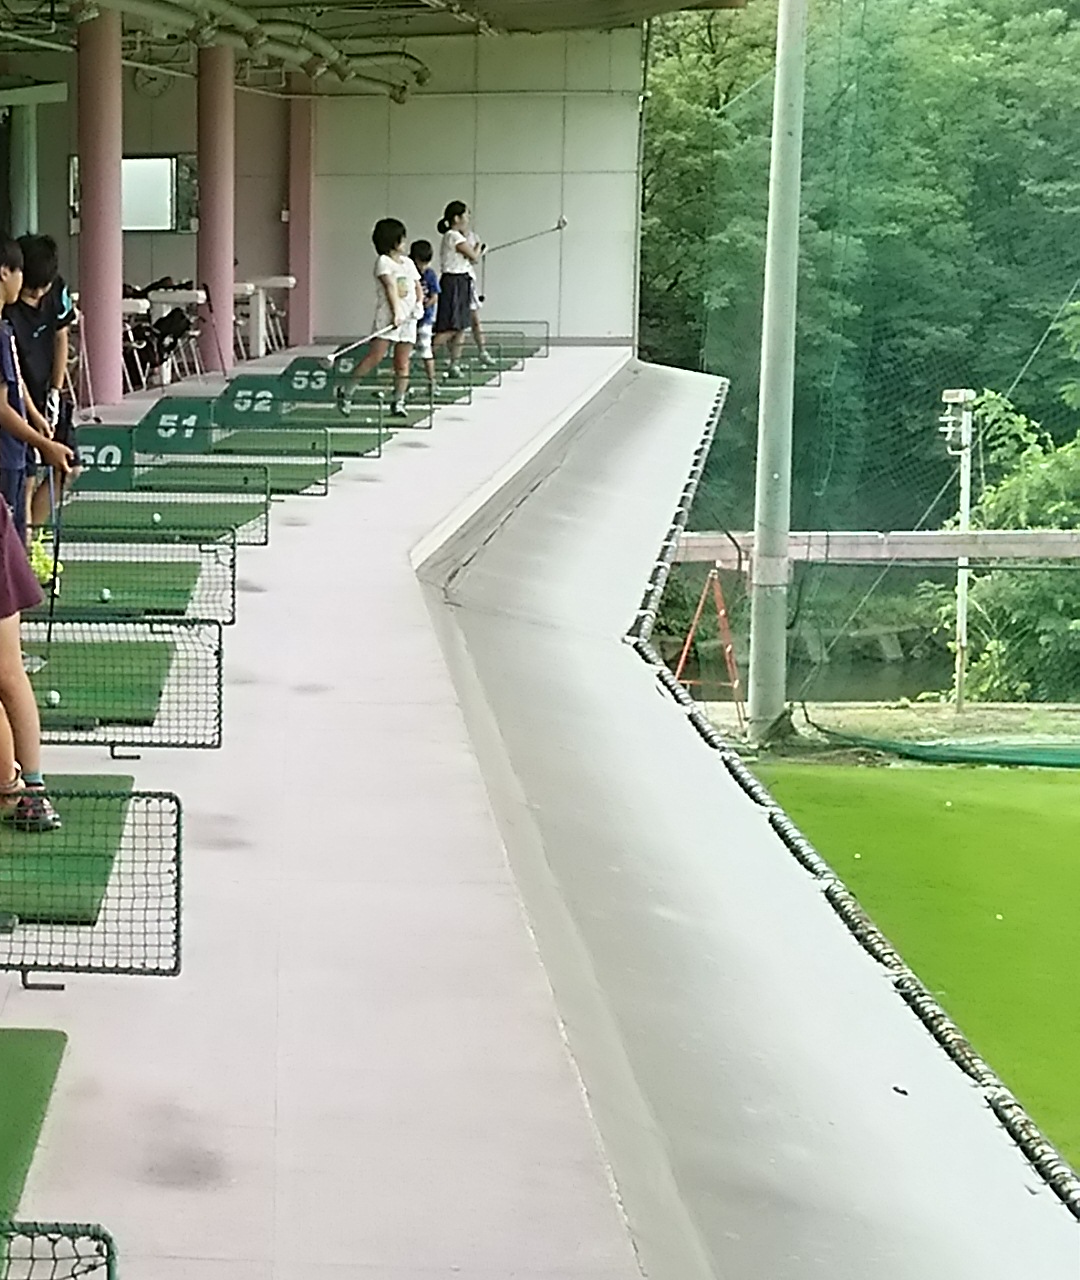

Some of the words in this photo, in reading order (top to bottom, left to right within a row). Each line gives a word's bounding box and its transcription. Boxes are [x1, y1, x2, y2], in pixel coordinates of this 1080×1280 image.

[292, 371, 327, 390] 53
[233, 390, 274, 412] 52
[157, 414, 197, 438] 51
[77, 444, 122, 472] 50
